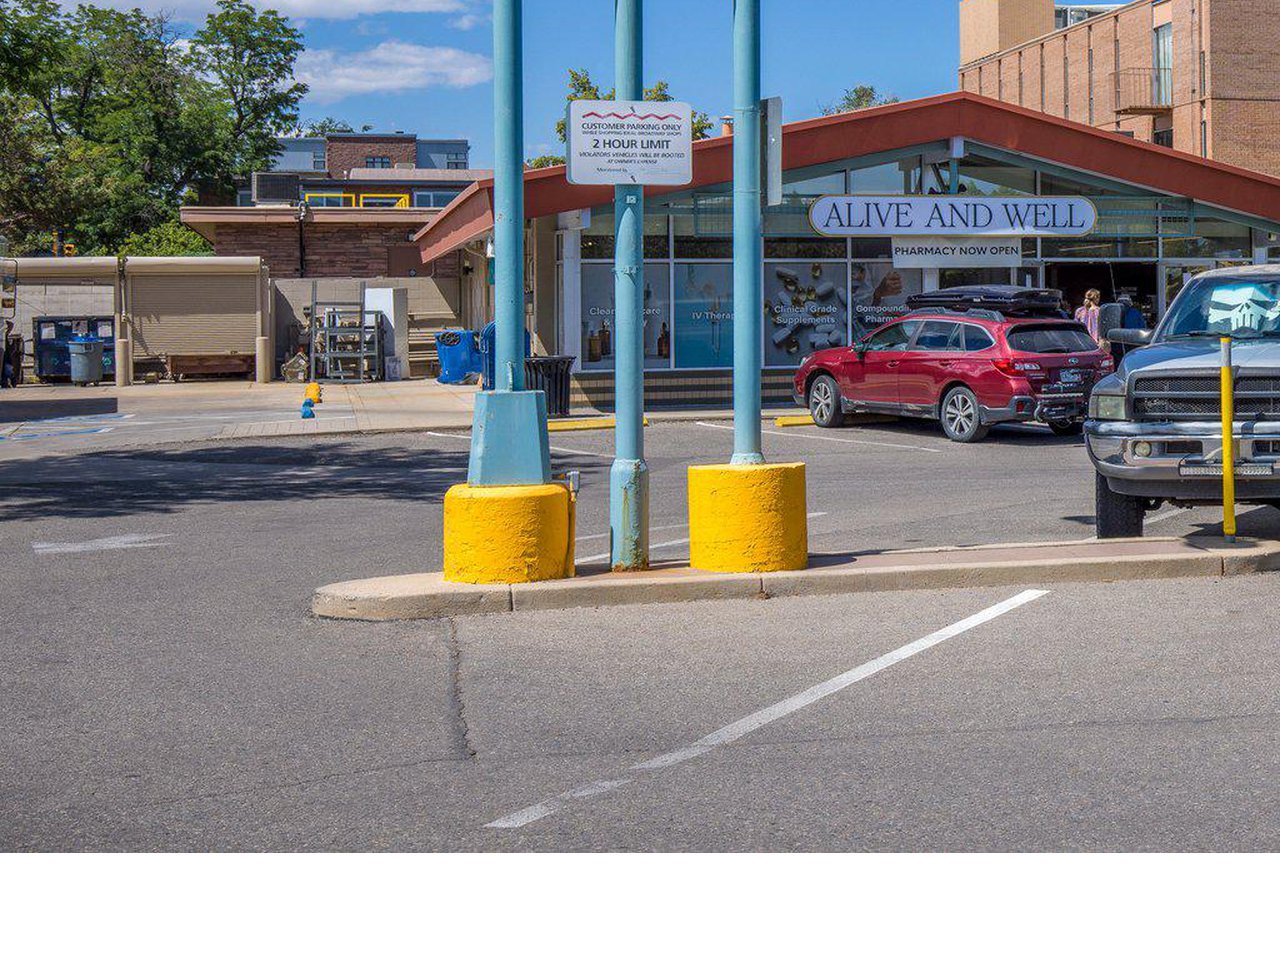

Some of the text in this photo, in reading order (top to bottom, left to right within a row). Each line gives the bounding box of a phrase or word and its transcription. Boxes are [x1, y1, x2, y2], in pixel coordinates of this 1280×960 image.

[582, 122, 625, 130] CUSTOMER
[627, 123, 660, 131] PARKING
[592, 139, 671, 149] 2 HOUR LIMIT
[823, 202, 1086, 230] ALIVE AND WELL
[894, 246, 1020, 257] PHARMACY NOW OPEN
[774, 304, 838, 314] Clinical Grade
[776, 315, 836, 325] Supplements
